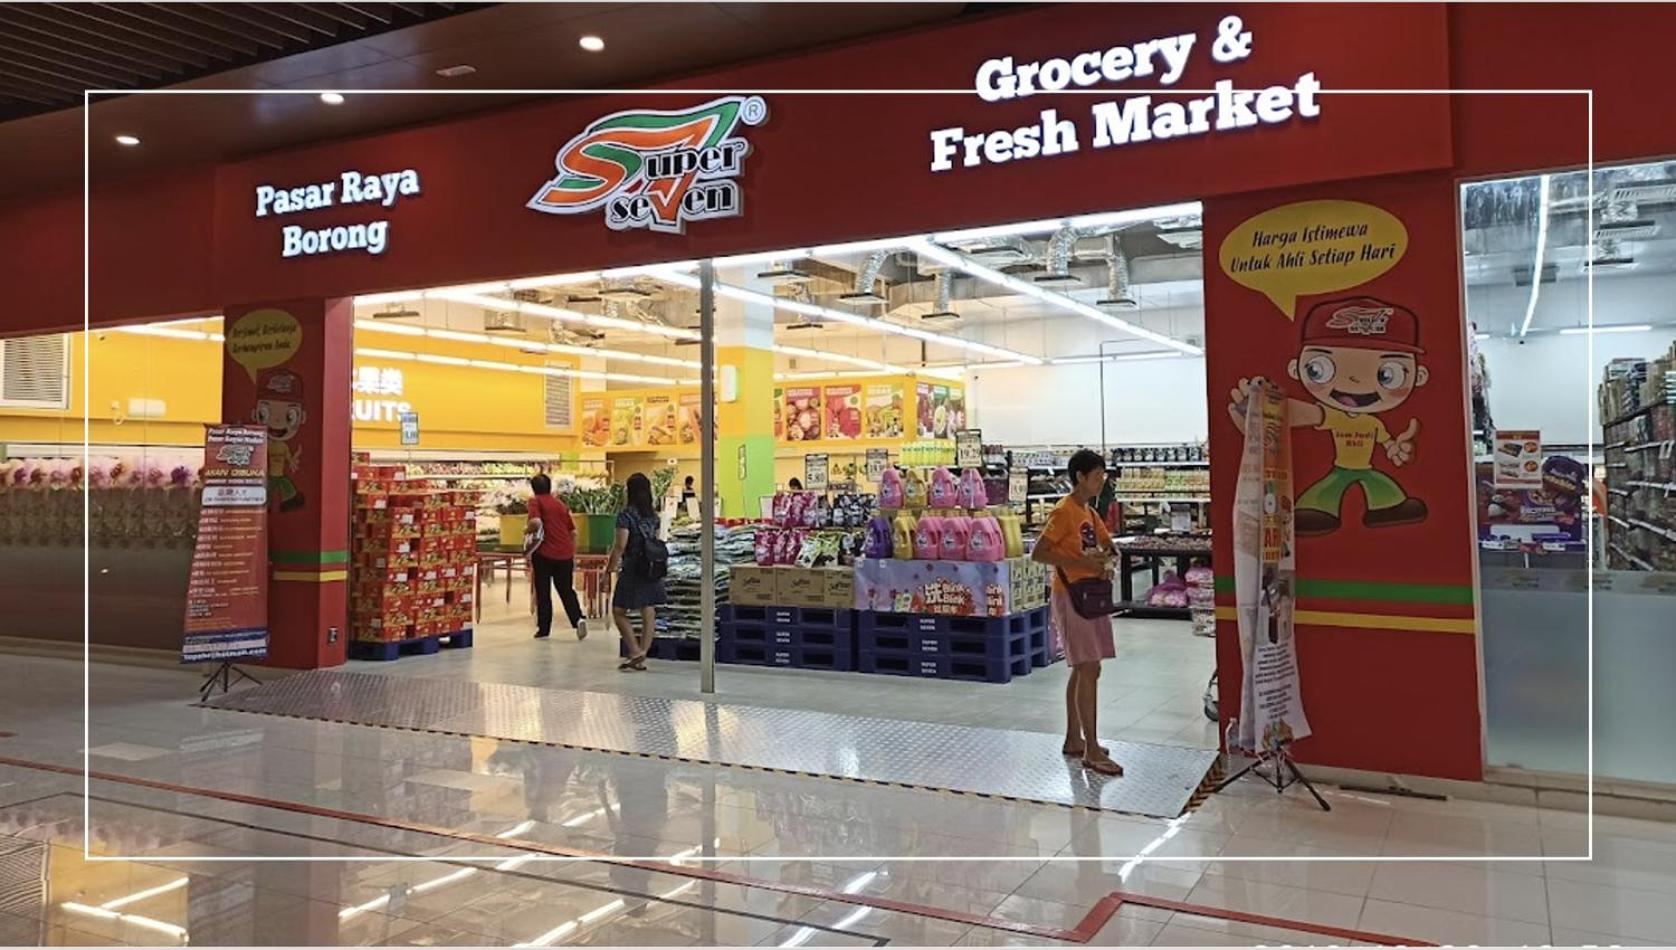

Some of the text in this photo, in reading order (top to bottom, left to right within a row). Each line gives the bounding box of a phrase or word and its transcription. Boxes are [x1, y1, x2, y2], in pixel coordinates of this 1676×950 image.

[975, 15, 1252, 102] Grocery &
[930, 72, 1320, 171] Fresh Market
[255, 168, 420, 217] Pasar Raya
[281, 219, 389, 257] Borong
[1252, 222, 1369, 248] Harga Istimewa
[1230, 243, 1396, 273] Untuk Ahli Setiap Hari
[352, 399, 412, 423] UITS
